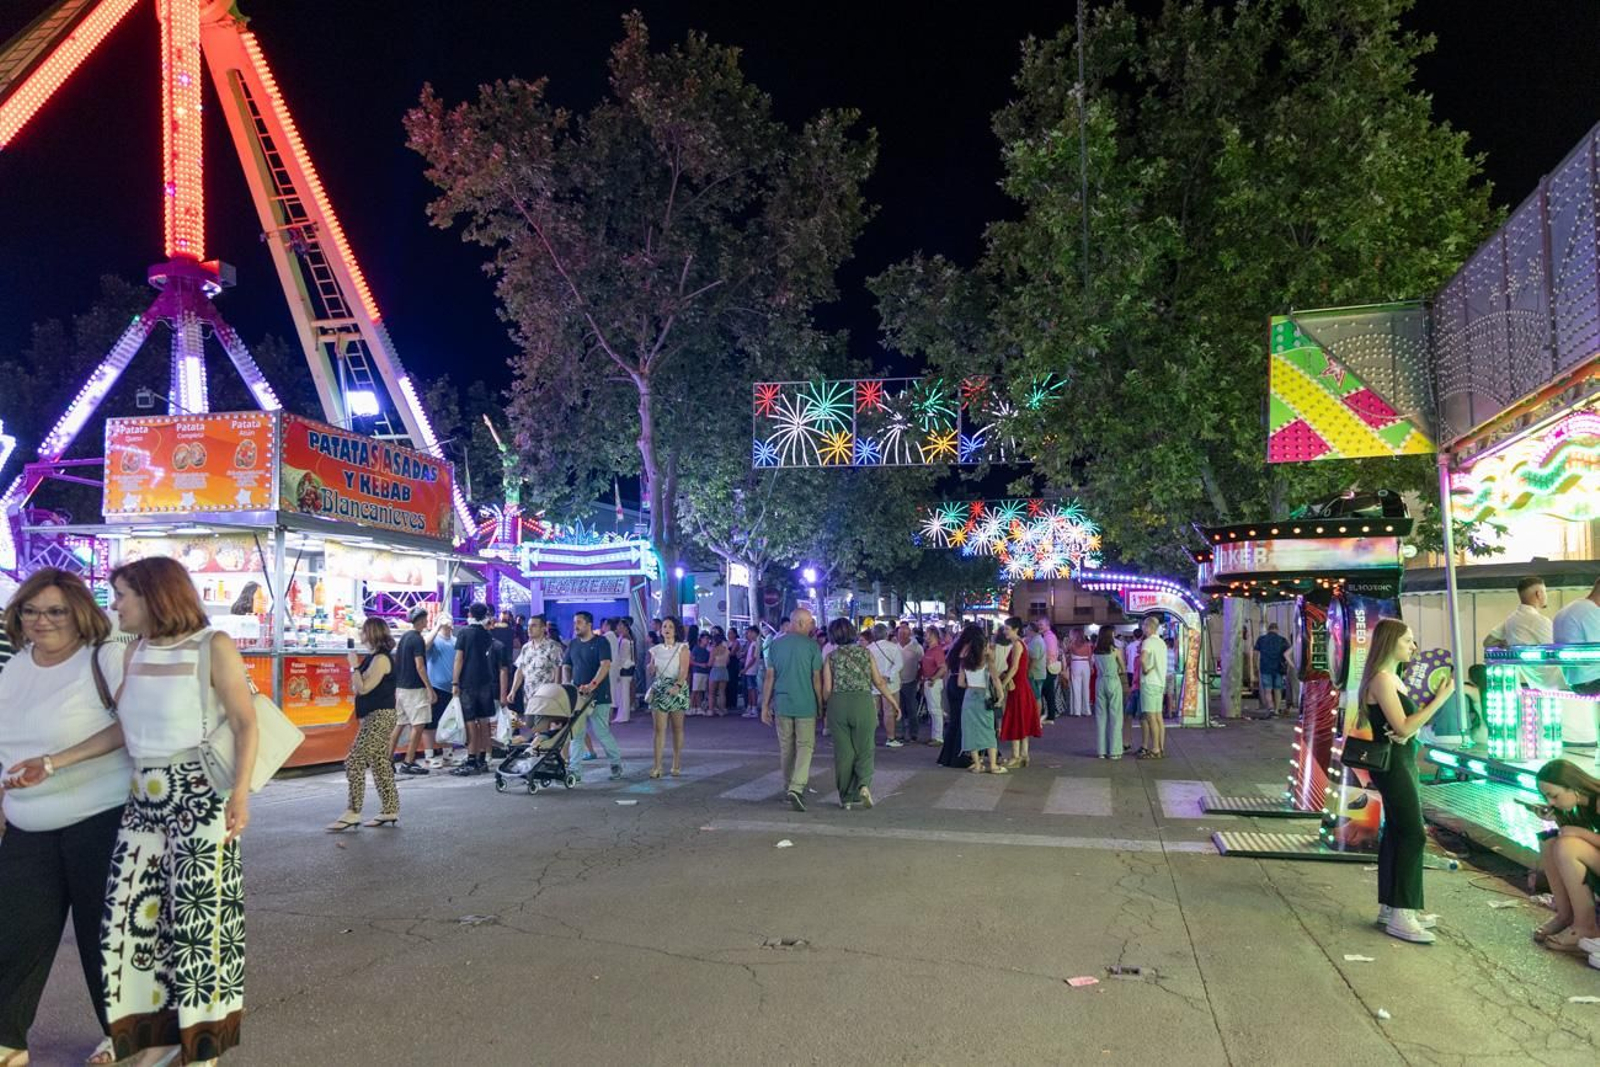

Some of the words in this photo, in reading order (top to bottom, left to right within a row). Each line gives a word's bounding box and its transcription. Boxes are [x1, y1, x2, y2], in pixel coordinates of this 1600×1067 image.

[119, 425, 149, 434] Patata
[176, 423, 205, 432] Patata
[232, 420, 261, 429] Patata
[308, 431, 379, 469] PATATAS
[382, 446, 439, 482] ASADAS
[343, 470, 355, 489] Y
[358, 472, 412, 502] KEBAB
[320, 487, 426, 530] Blancanieves
[1355, 609, 1367, 644] SPEED
